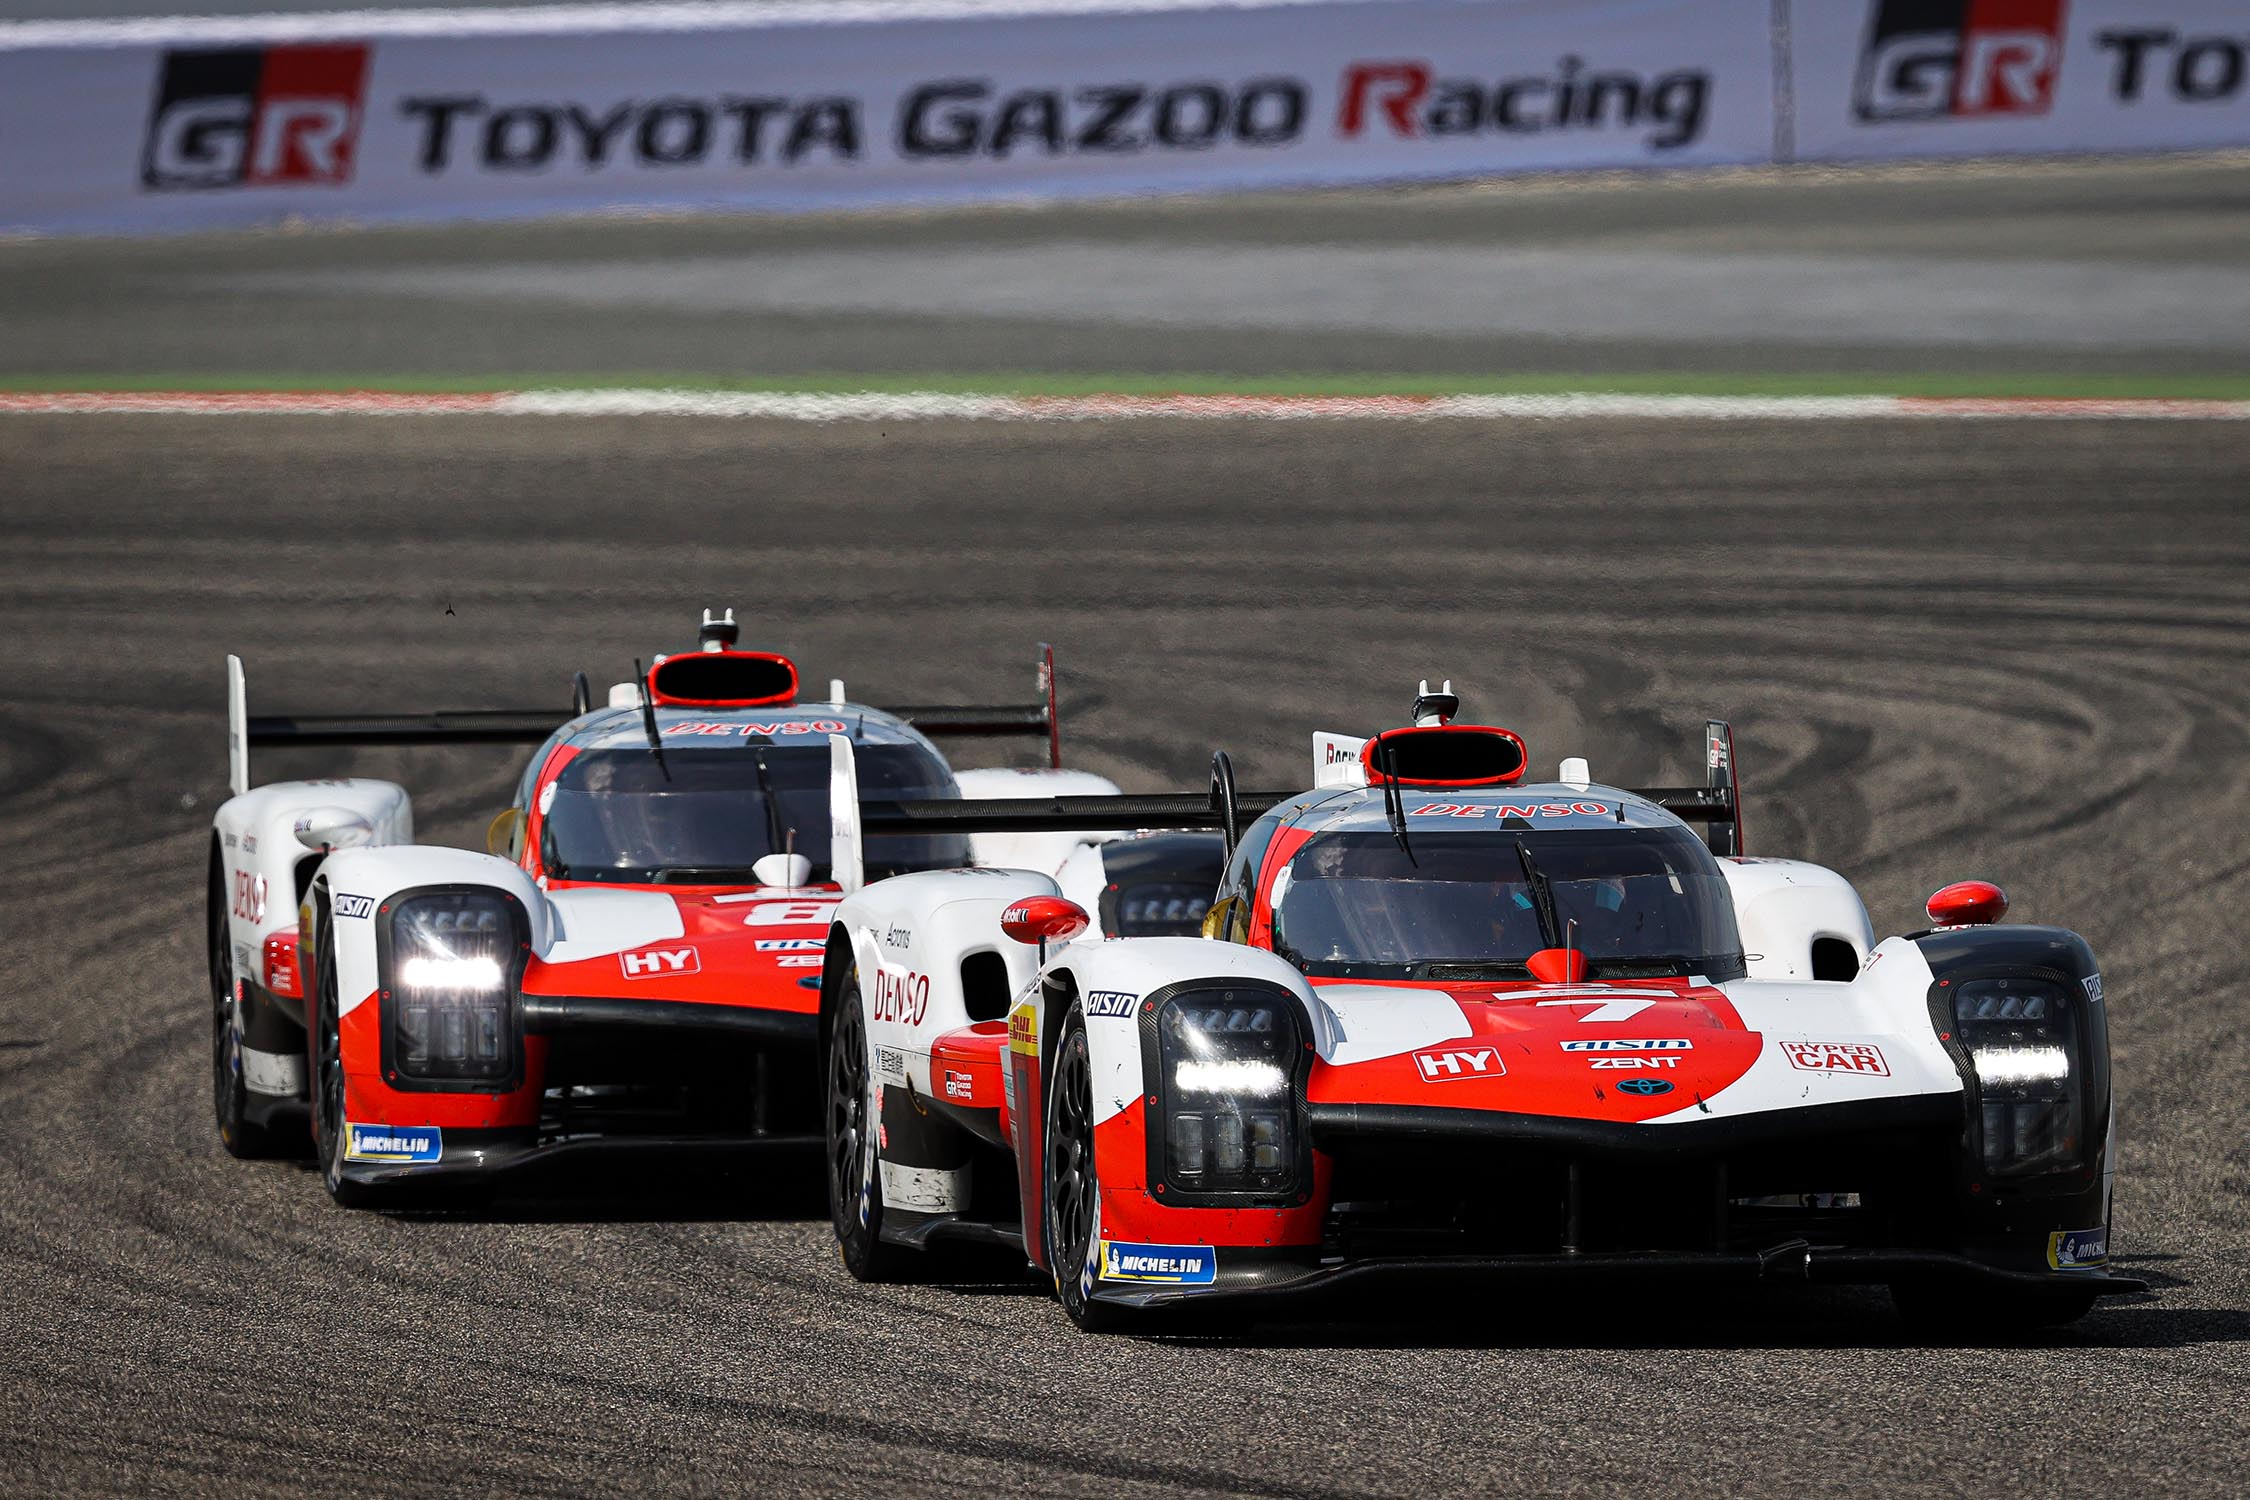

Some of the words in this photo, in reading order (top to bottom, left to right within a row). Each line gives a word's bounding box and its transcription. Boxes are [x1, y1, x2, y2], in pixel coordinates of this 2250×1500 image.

[1873, 29, 2052, 113] GR
[150, 94, 355, 183] GR
[399, 92, 864, 174] TOYOTA
[896, 75, 1310, 160] GAZOO
[1335, 54, 1712, 150] Racing
[663, 720, 847, 736] DENSO
[1409, 802, 1608, 818] DENSO
[885, 921, 911, 949] Acronis
[624, 949, 692, 974] HY
[776, 955, 824, 967] ZE
[874, 968, 930, 1026] DENSO
[1087, 993, 1136, 1016] AISIN
[1566, 1040, 1687, 1050] AISIN
[1788, 1043, 1874, 1056] HYPER
[1419, 1050, 1491, 1076] HY
[1588, 1056, 1682, 1069] ZENT
[1795, 1052, 1881, 1072] CAR
[361, 1135, 429, 1152] MICHELIN
[1121, 1255, 1202, 1273] MICHELIN
